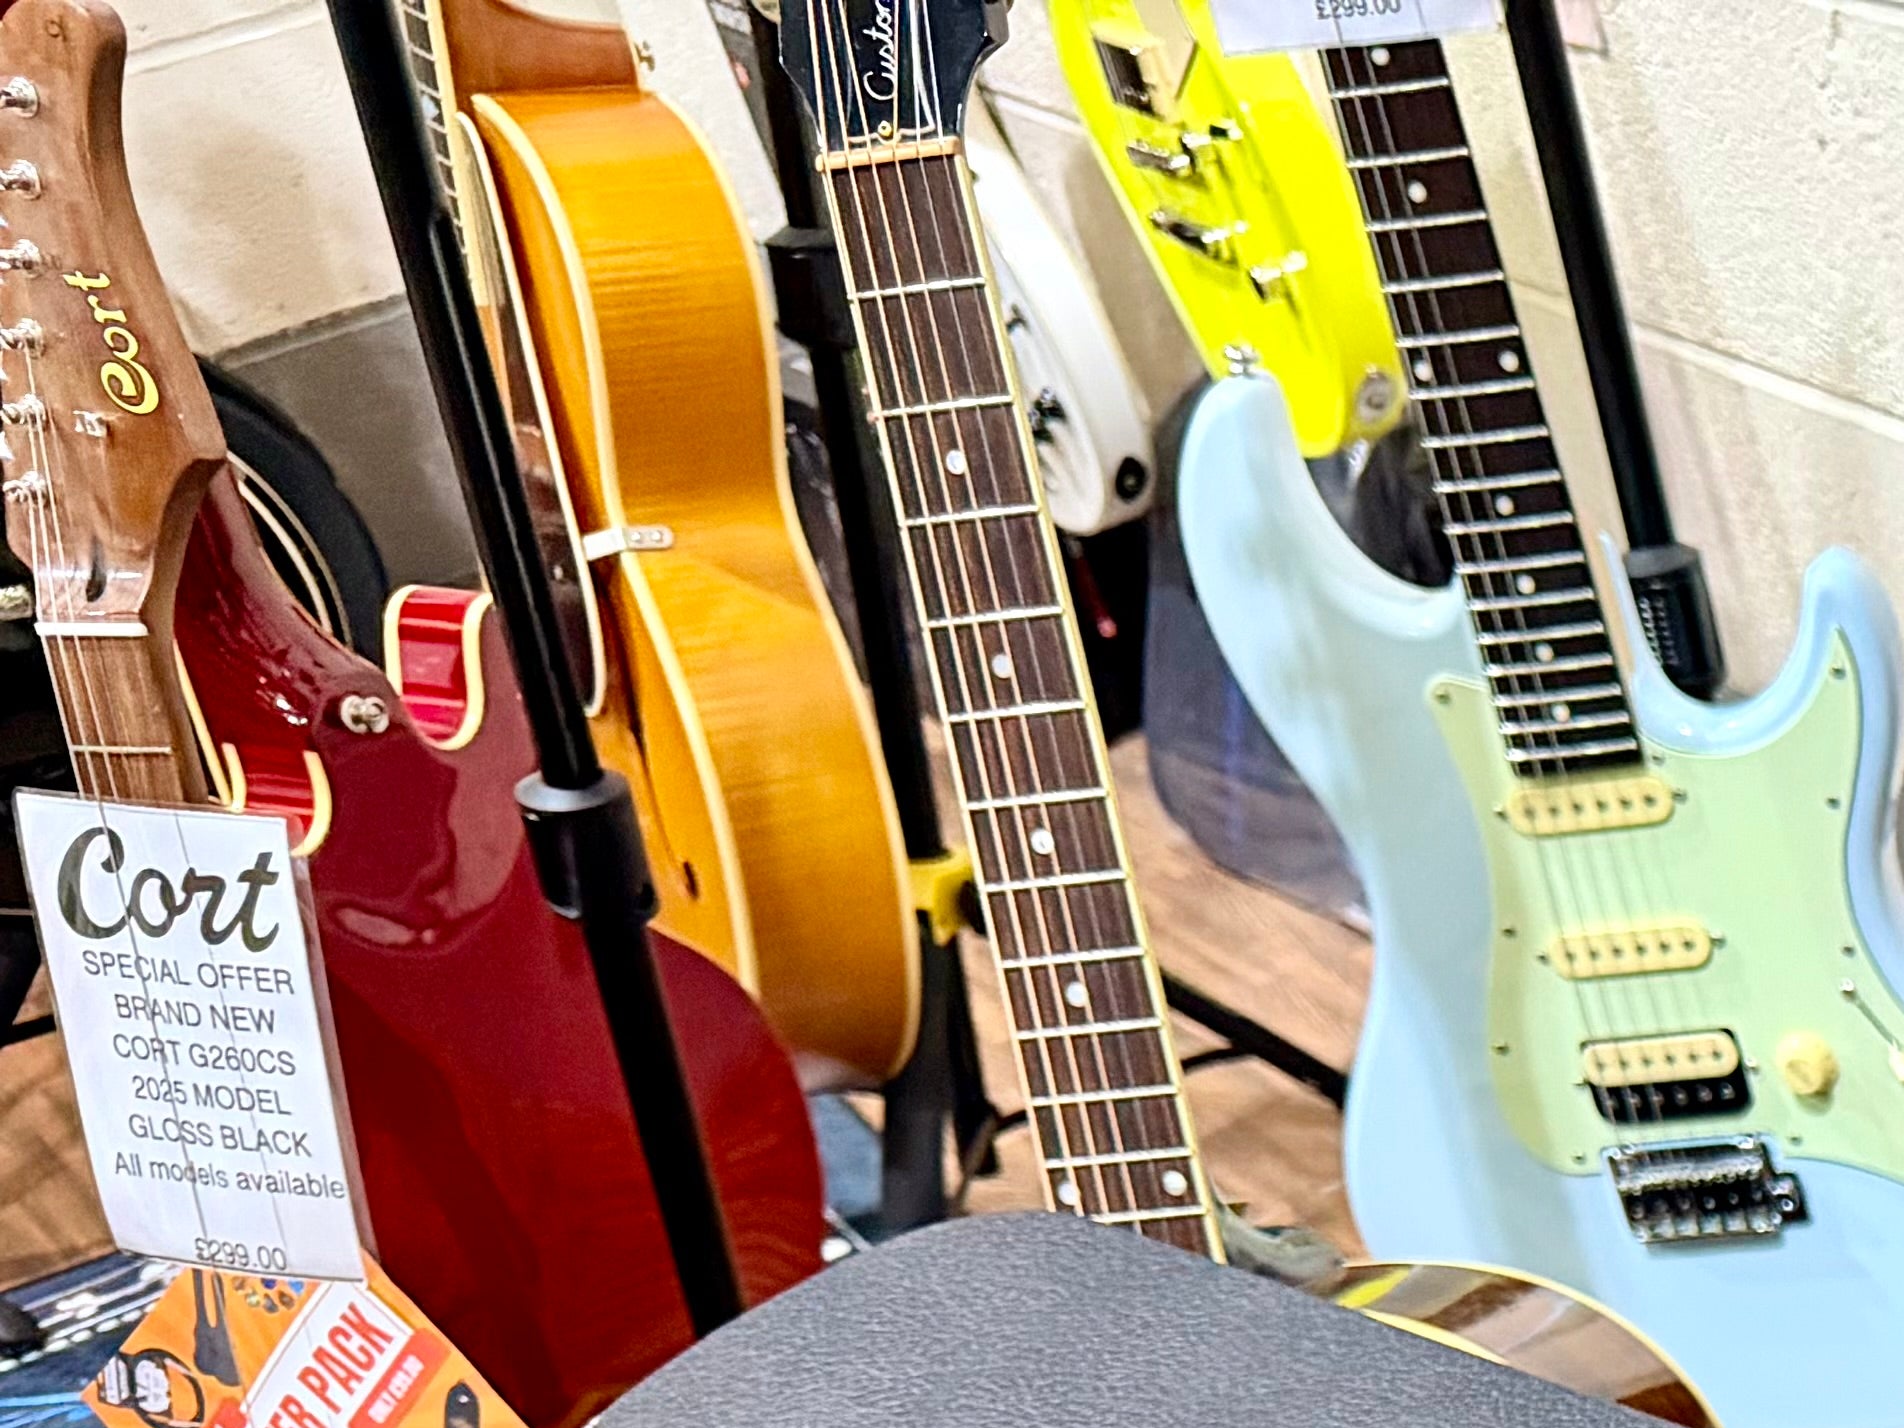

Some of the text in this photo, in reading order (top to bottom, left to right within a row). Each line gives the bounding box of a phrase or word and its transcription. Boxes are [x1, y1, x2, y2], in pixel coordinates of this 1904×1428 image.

[862, 0, 898, 100] Custo
[62, 271, 159, 414] Cort
[57, 826, 280, 953] Cort
[82, 950, 295, 995] SPECIAL OFFER
[114, 993, 275, 1034] BRAND NEW
[113, 1034, 296, 1076] CORT G260CS
[132, 1075, 292, 1115] 2025 MODEL
[129, 1114, 312, 1157] GLOSS BLACK
[115, 1152, 345, 1199] All models available
[195, 1237, 287, 1271] £299.00
[297, 1302, 394, 1415] PACK
